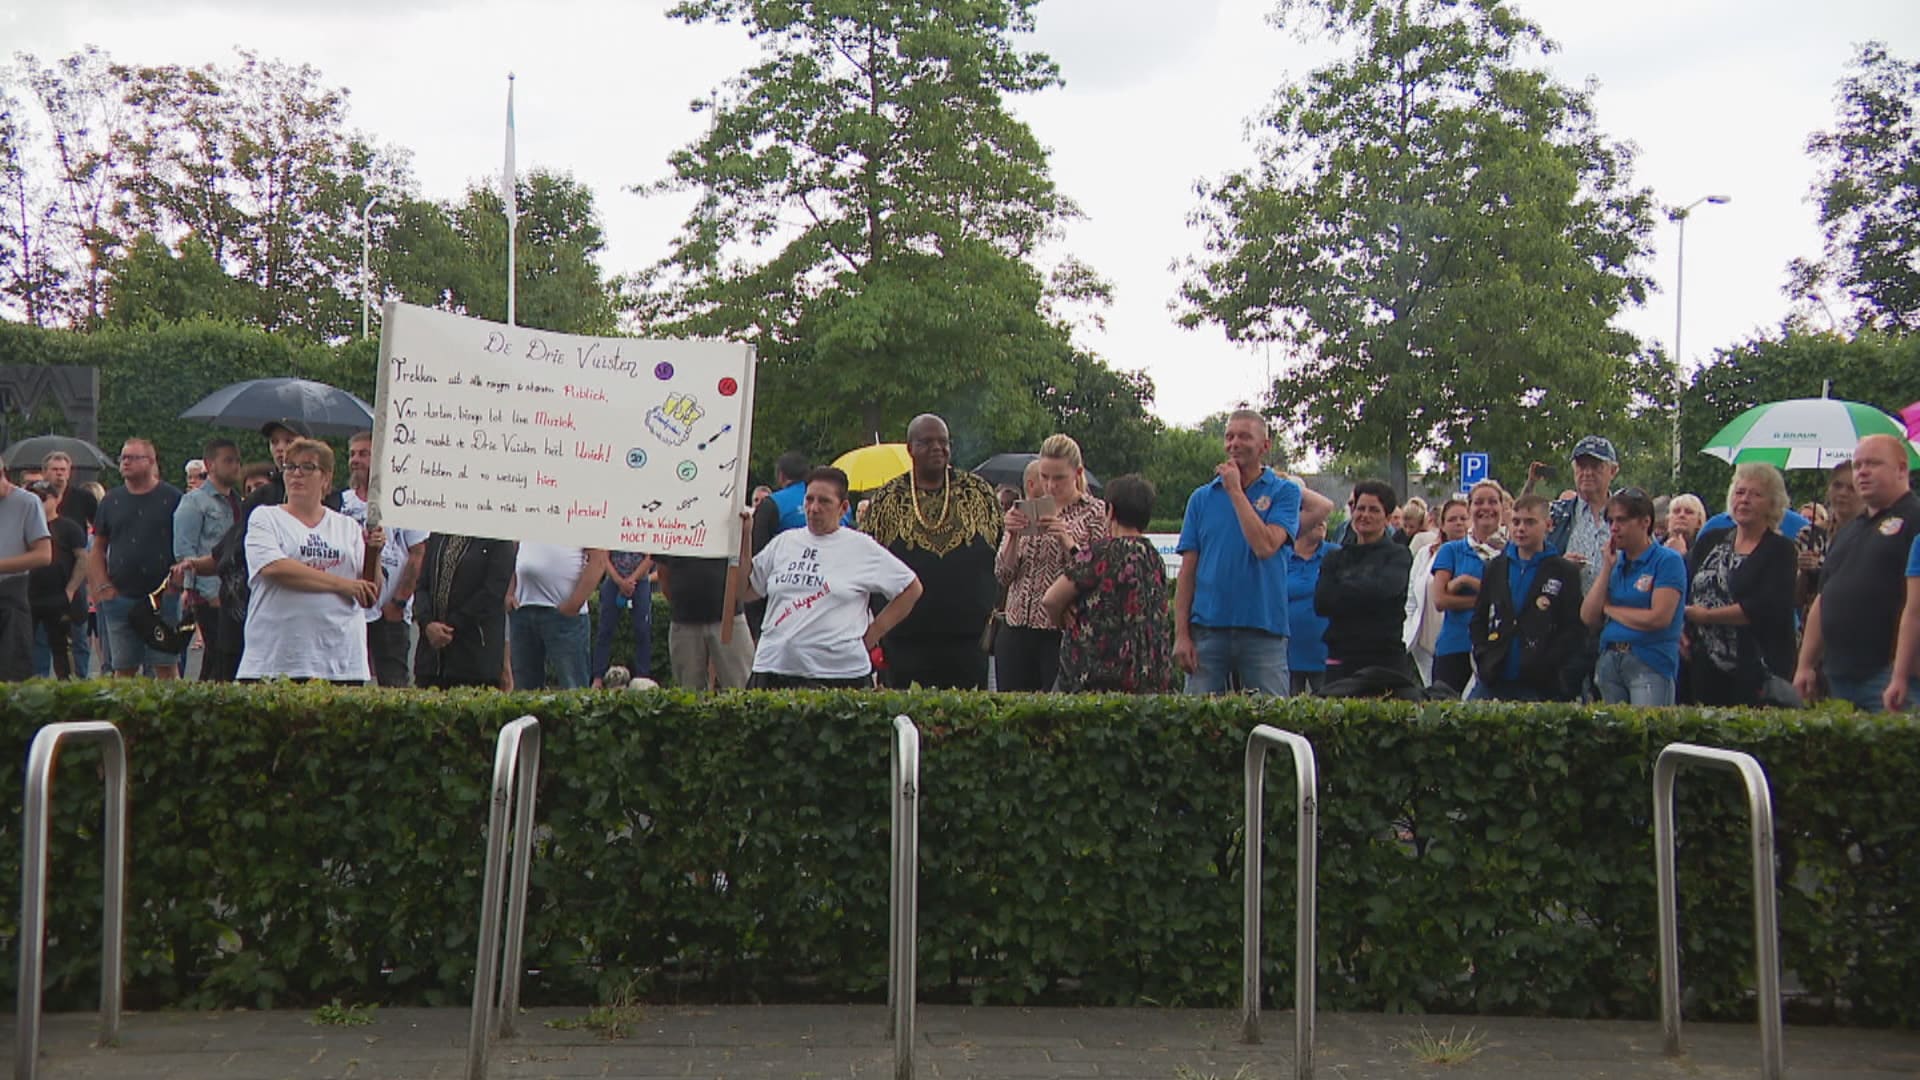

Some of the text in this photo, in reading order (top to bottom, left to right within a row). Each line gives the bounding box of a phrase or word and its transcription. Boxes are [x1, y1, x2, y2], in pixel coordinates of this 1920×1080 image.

[1467, 457, 1482, 477] P
[802, 547, 818, 560] DE
[788, 561, 820, 573] DRIE
